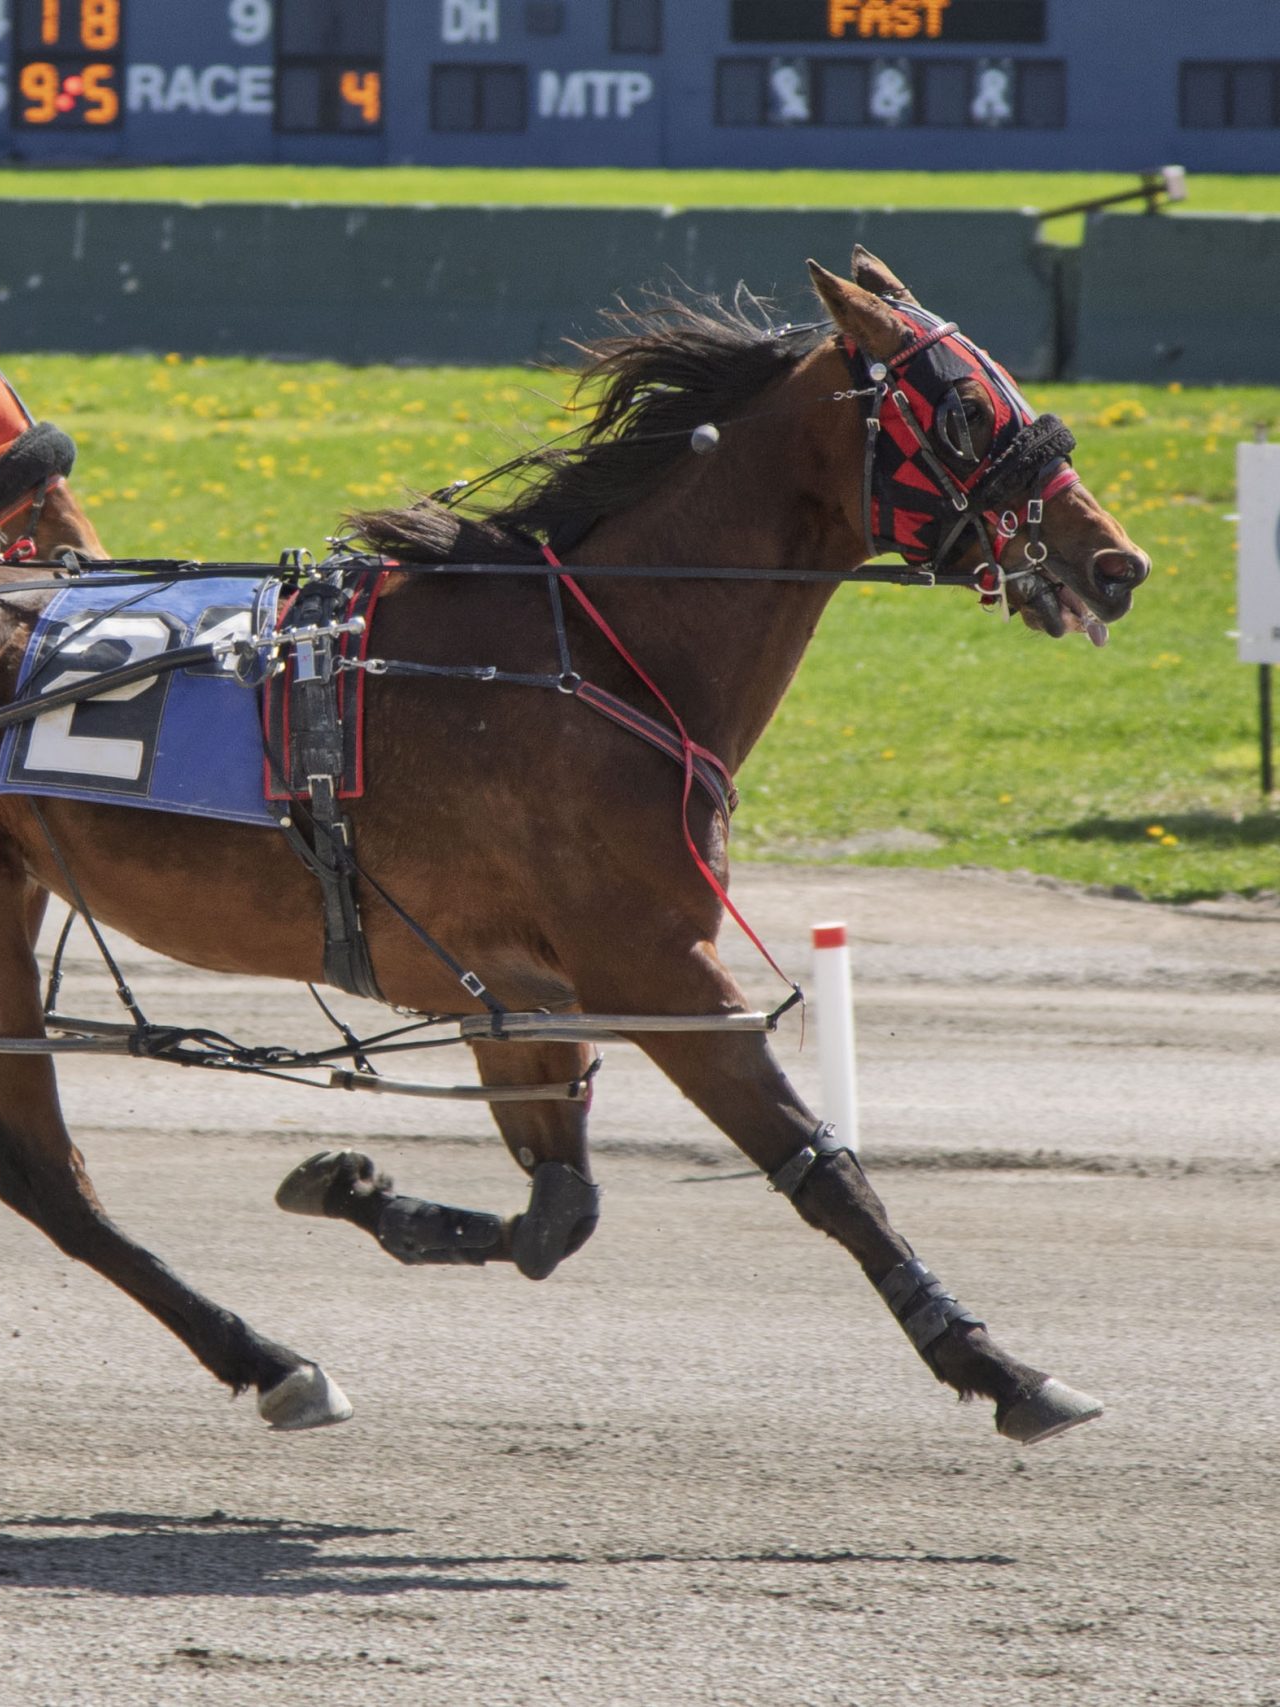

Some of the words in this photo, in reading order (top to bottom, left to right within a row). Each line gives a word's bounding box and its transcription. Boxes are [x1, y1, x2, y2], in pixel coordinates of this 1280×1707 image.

[41, 0, 120, 51] 18
[228, 0, 272, 46] 9
[441, 0, 500, 44] DH
[827, 0, 951, 38] FAST
[126, 63, 274, 115] RACE
[340, 70, 381, 124] 4
[538, 69, 654, 119] MTP
[24, 616, 172, 780] 2
